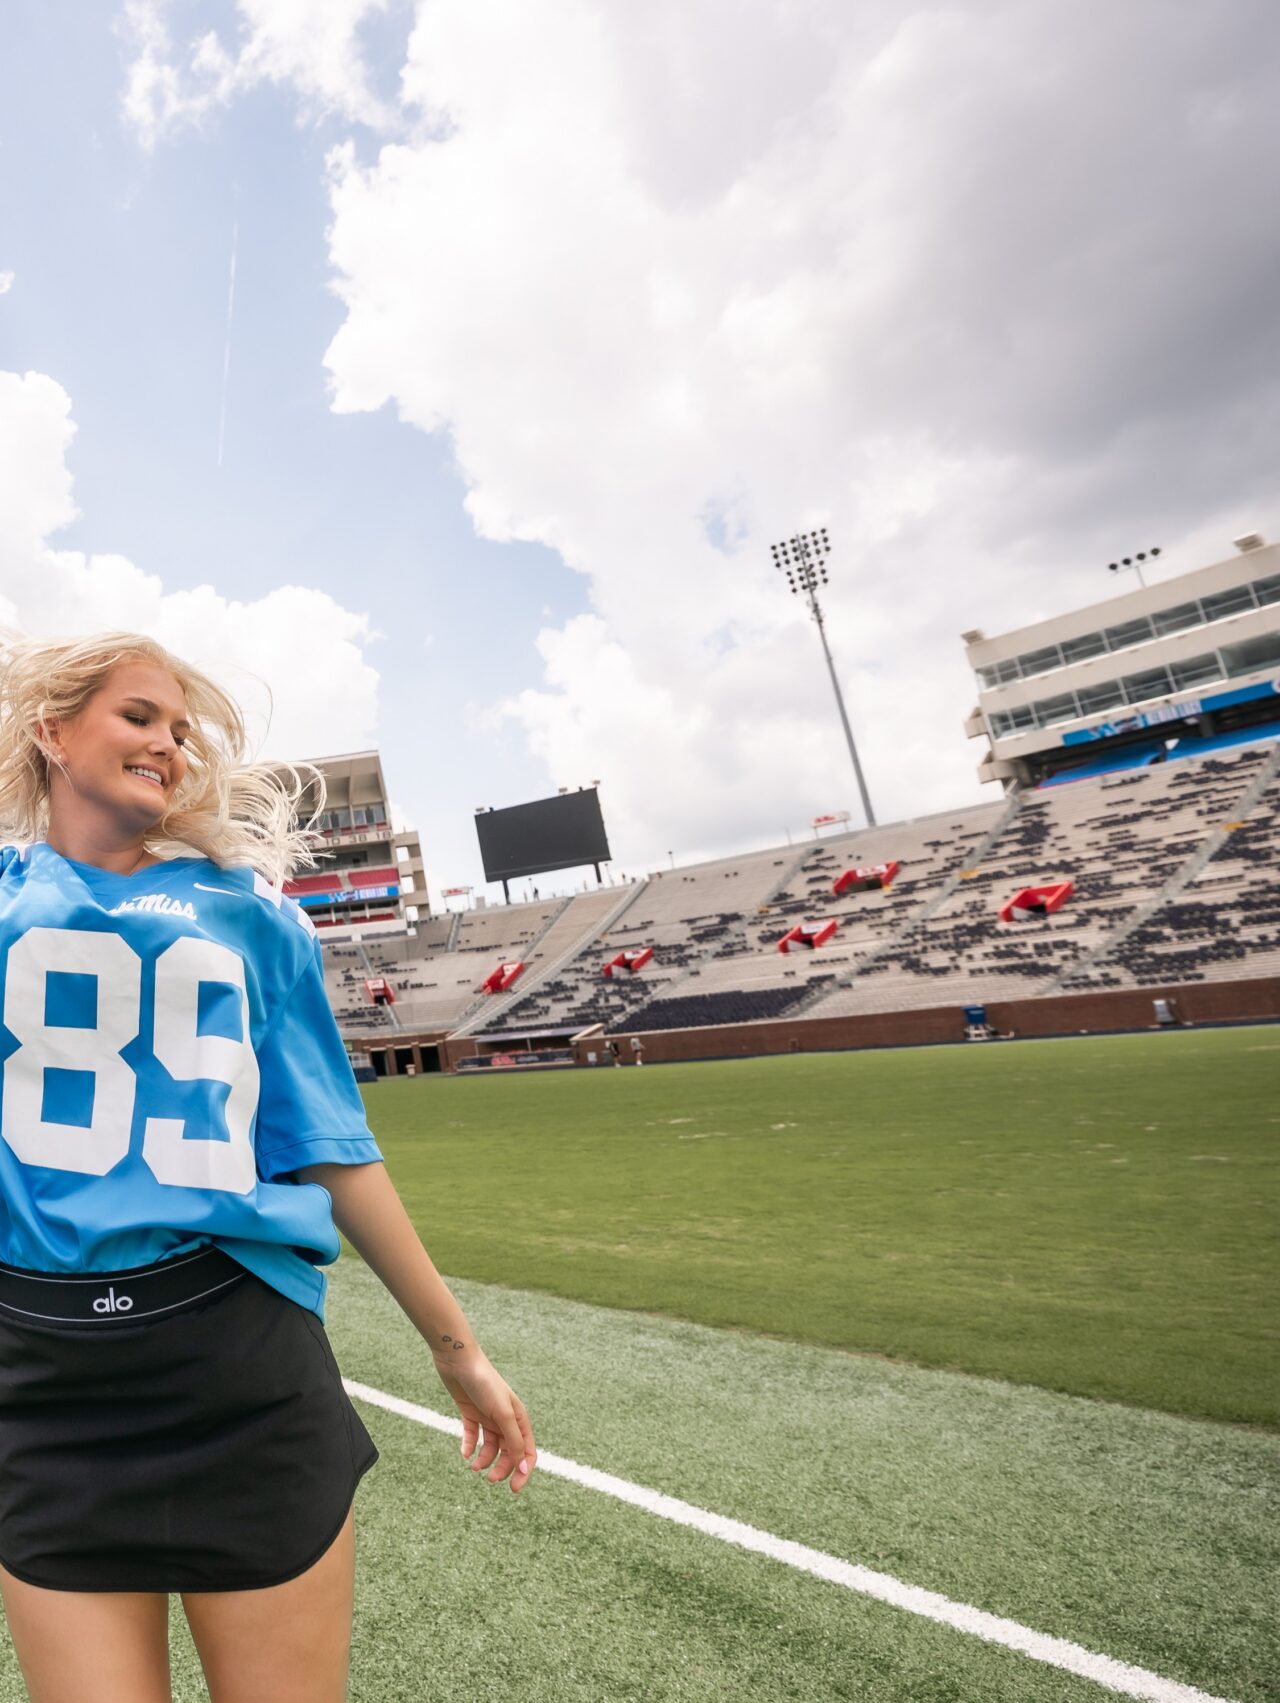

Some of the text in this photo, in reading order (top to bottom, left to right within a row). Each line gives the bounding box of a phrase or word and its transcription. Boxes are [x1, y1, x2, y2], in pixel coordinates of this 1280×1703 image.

[132, 893, 197, 920] Miss
[1, 927, 260, 1195] 89
[93, 1287, 133, 1313] alo
